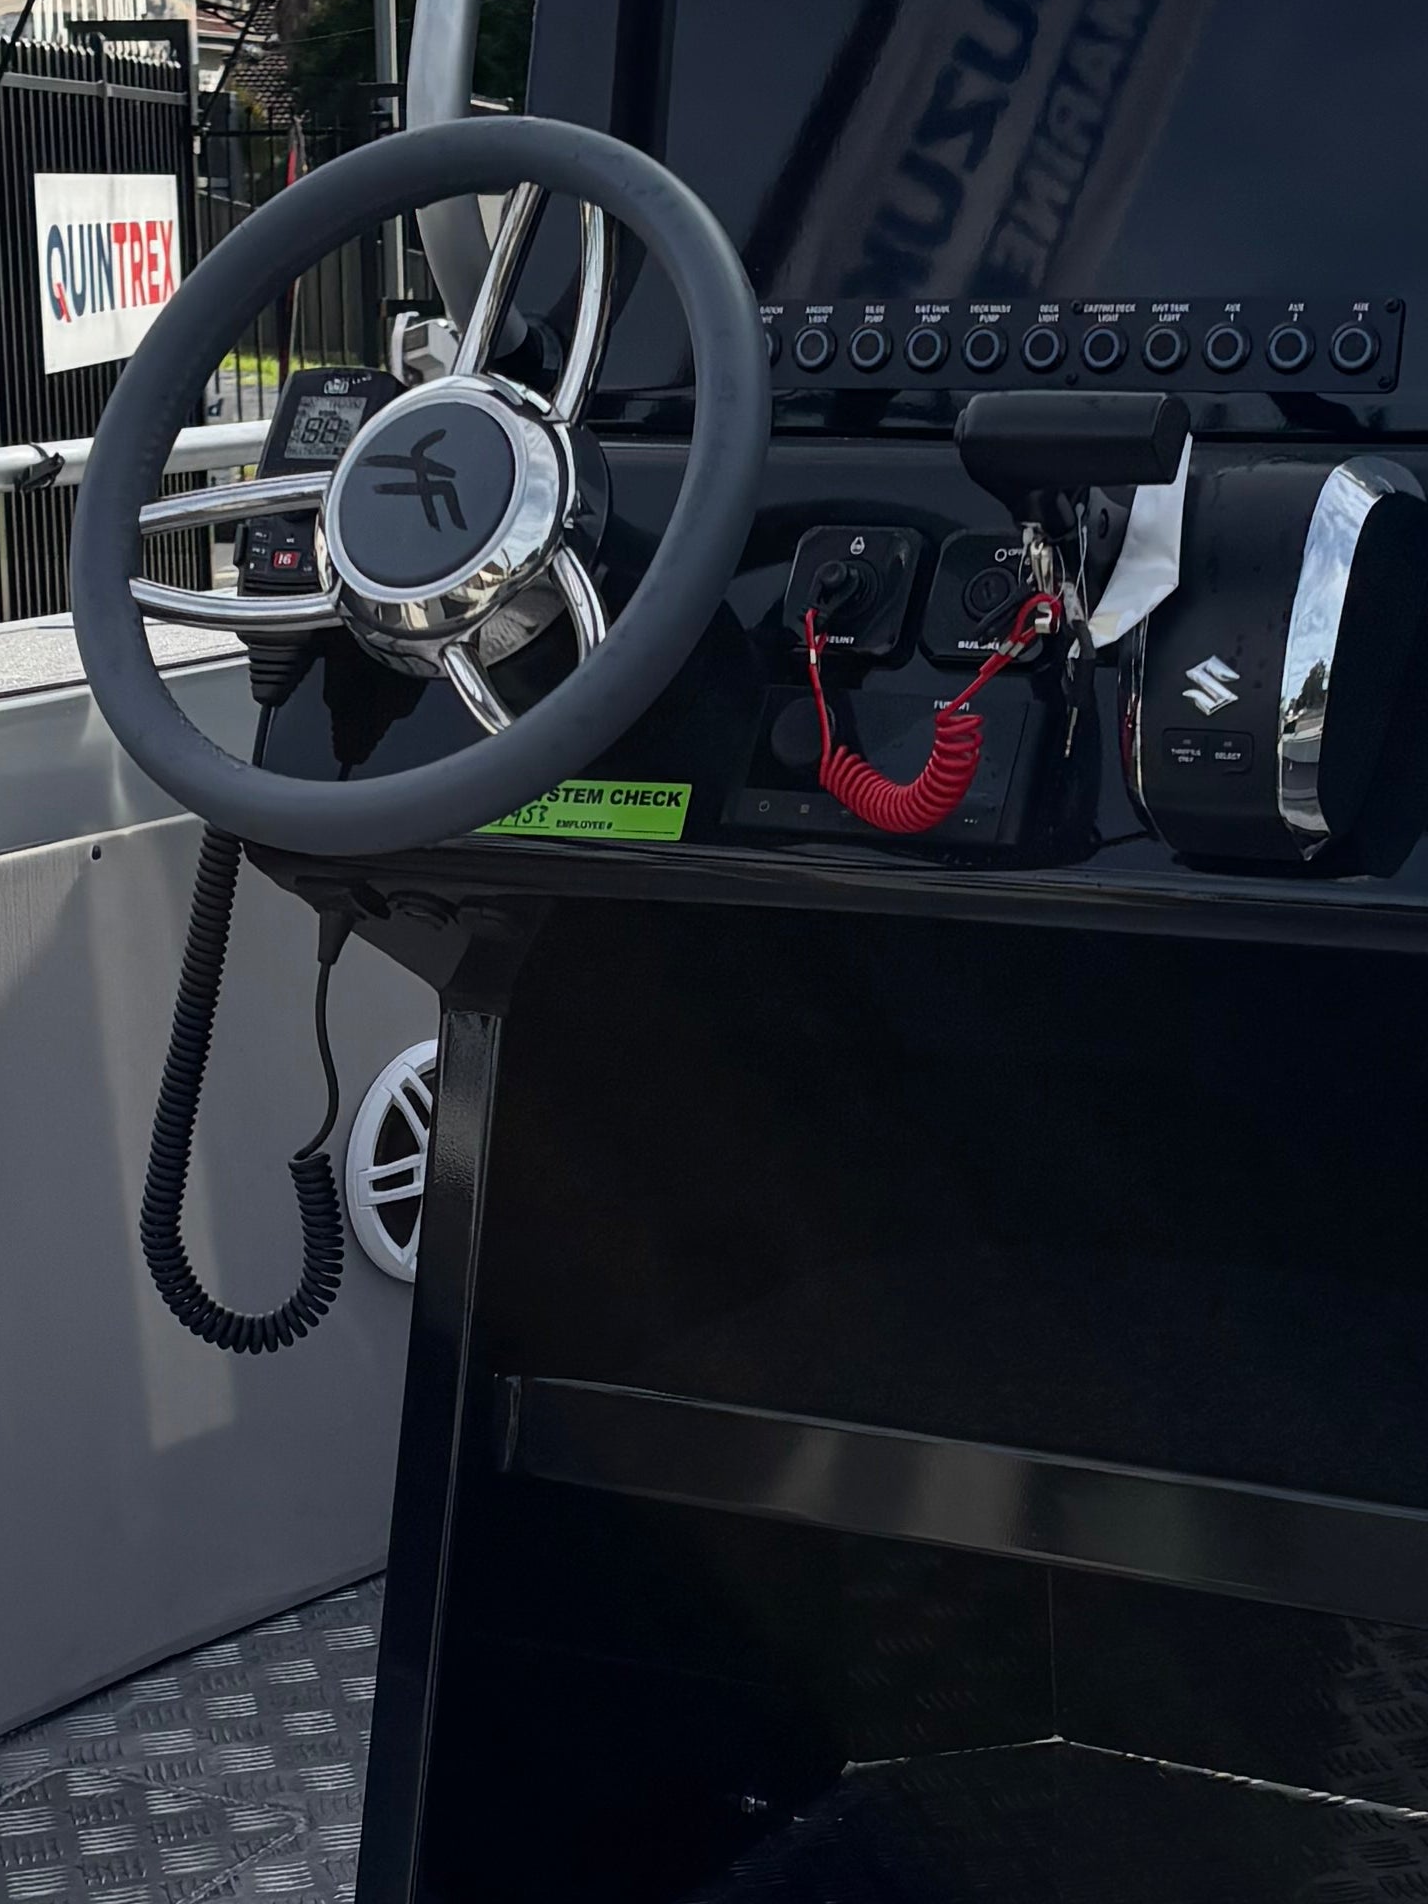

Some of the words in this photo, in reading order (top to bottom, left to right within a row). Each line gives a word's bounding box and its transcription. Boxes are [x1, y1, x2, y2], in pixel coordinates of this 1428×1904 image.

[47, 220, 174, 323] QUINTREX
[278, 553, 292, 565] 16
[610, 789, 684, 808] CHECK
